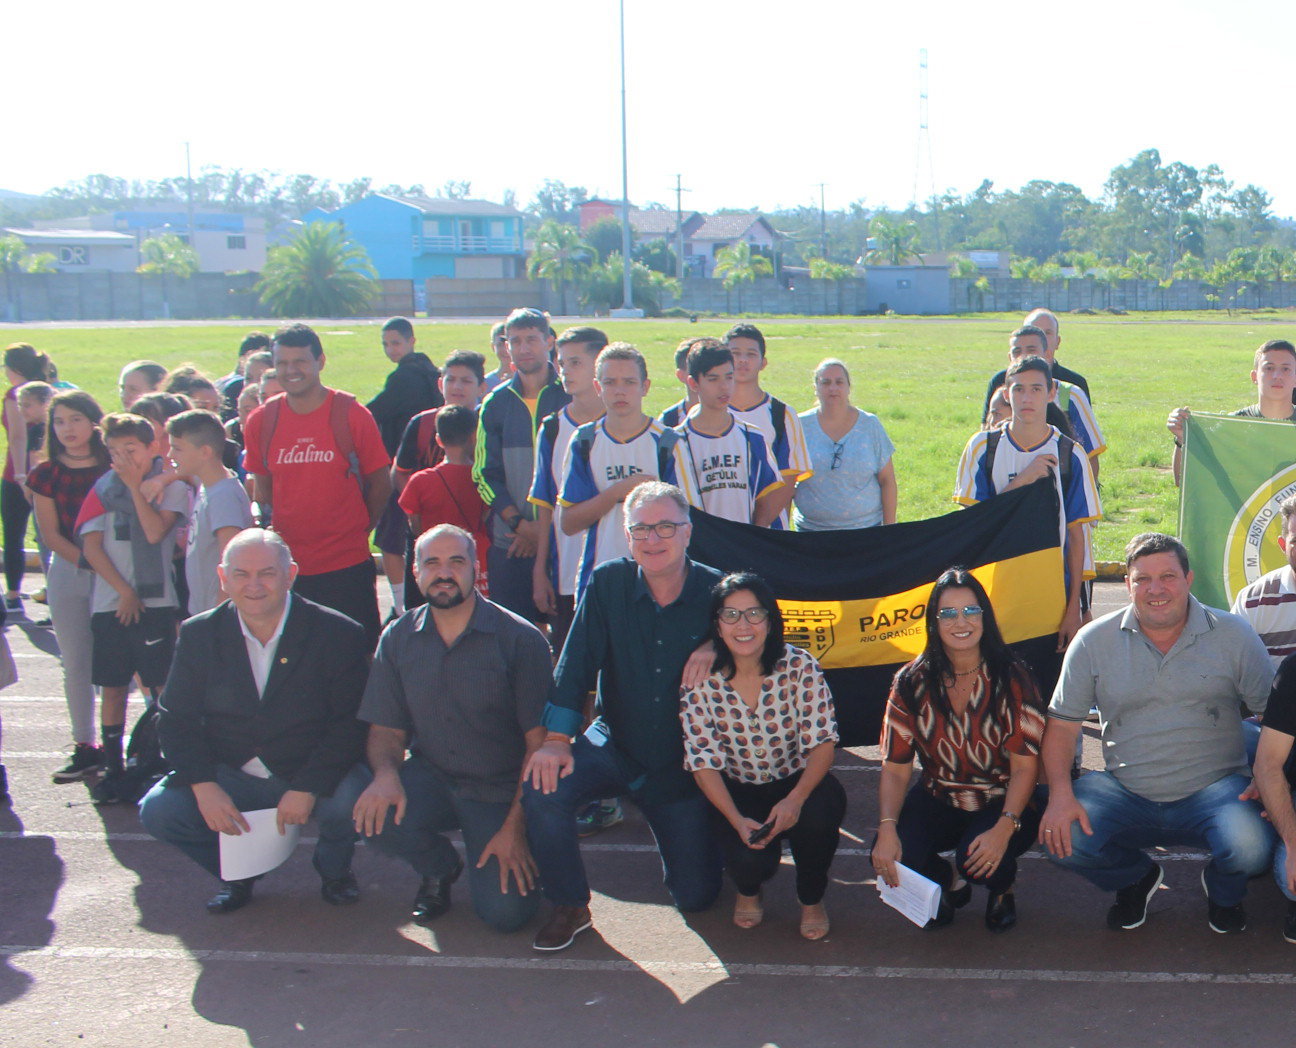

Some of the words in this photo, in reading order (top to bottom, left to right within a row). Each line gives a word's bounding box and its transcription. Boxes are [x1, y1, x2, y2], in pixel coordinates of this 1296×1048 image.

[60, 246, 85, 263] DR
[276, 444, 334, 464] Idalino
[1249, 508, 1273, 547] ENSINO
[860, 604, 926, 632] PARO
[861, 635, 877, 643] RIO
[879, 627, 922, 641] GRANDE
